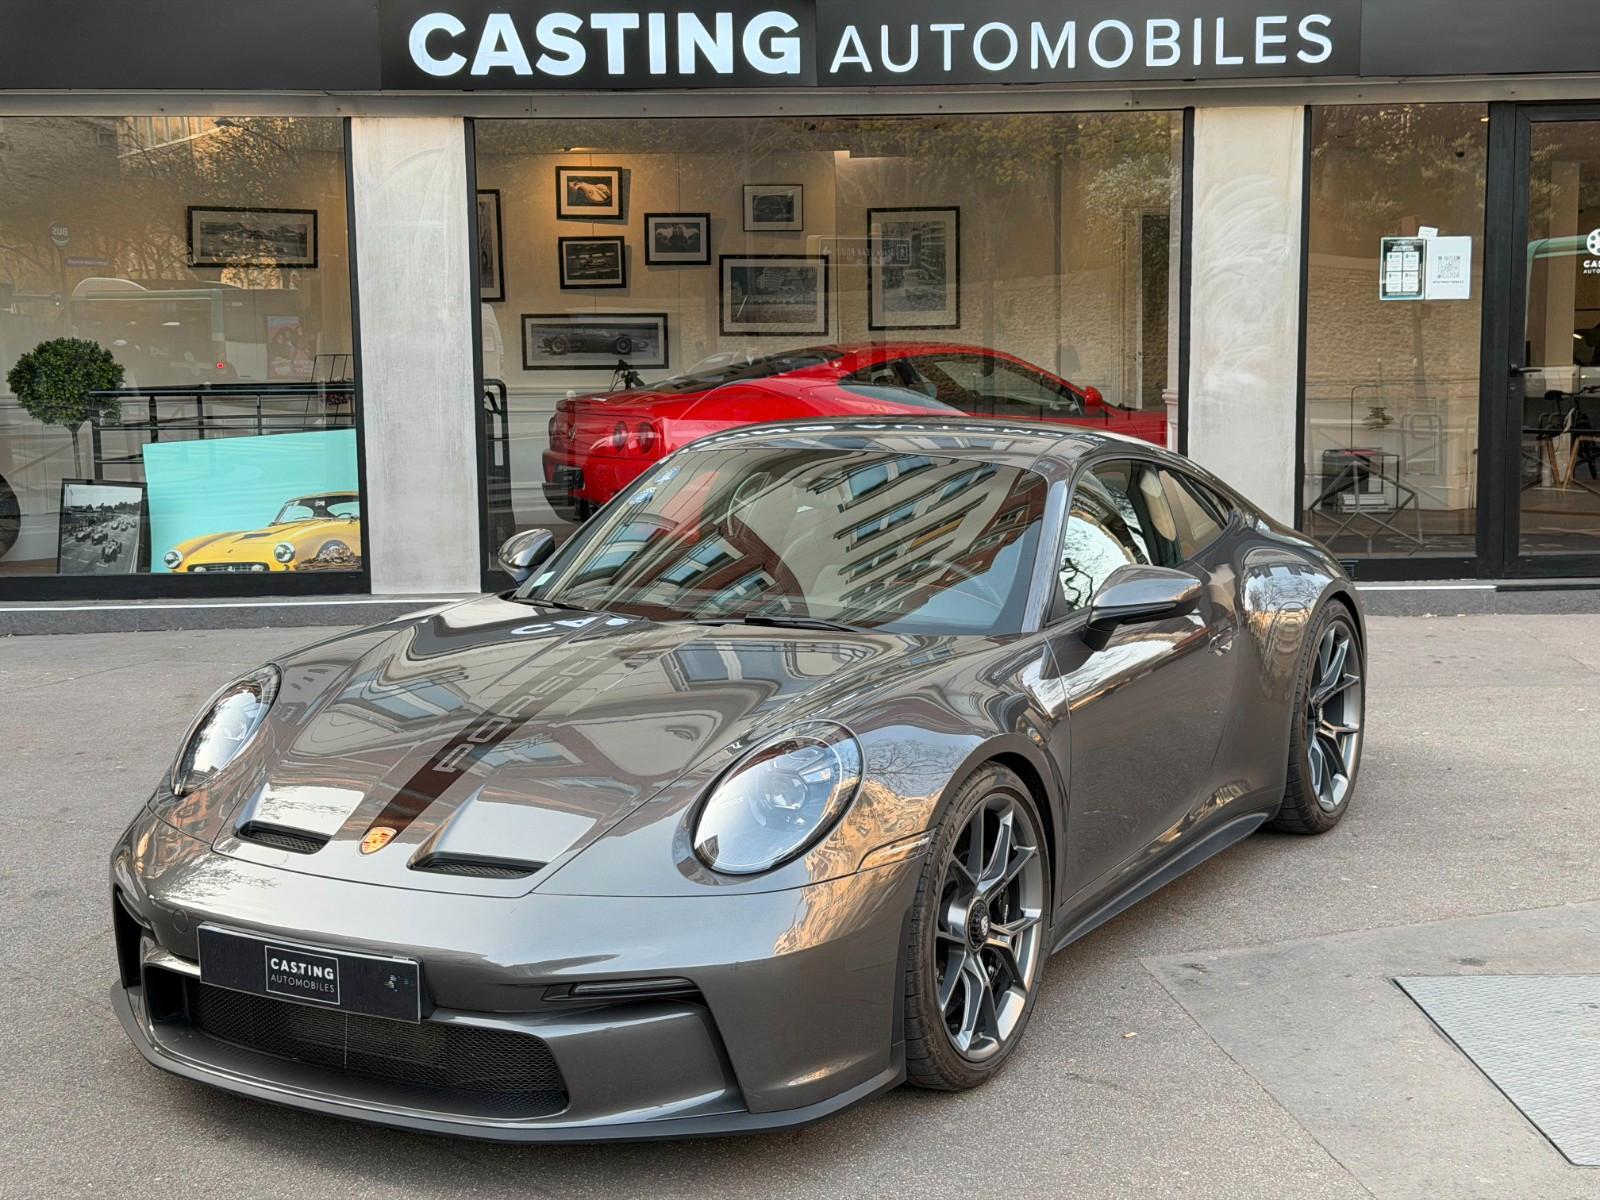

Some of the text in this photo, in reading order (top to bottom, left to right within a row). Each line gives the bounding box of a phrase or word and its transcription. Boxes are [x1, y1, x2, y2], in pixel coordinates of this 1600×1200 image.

[408, 11, 1333, 76] CASTING AUTOMOBILES
[1583, 260, 1600, 269] CA
[270, 957, 335, 980] CASTING
[270, 973, 335, 993] AUTOMOBILES
